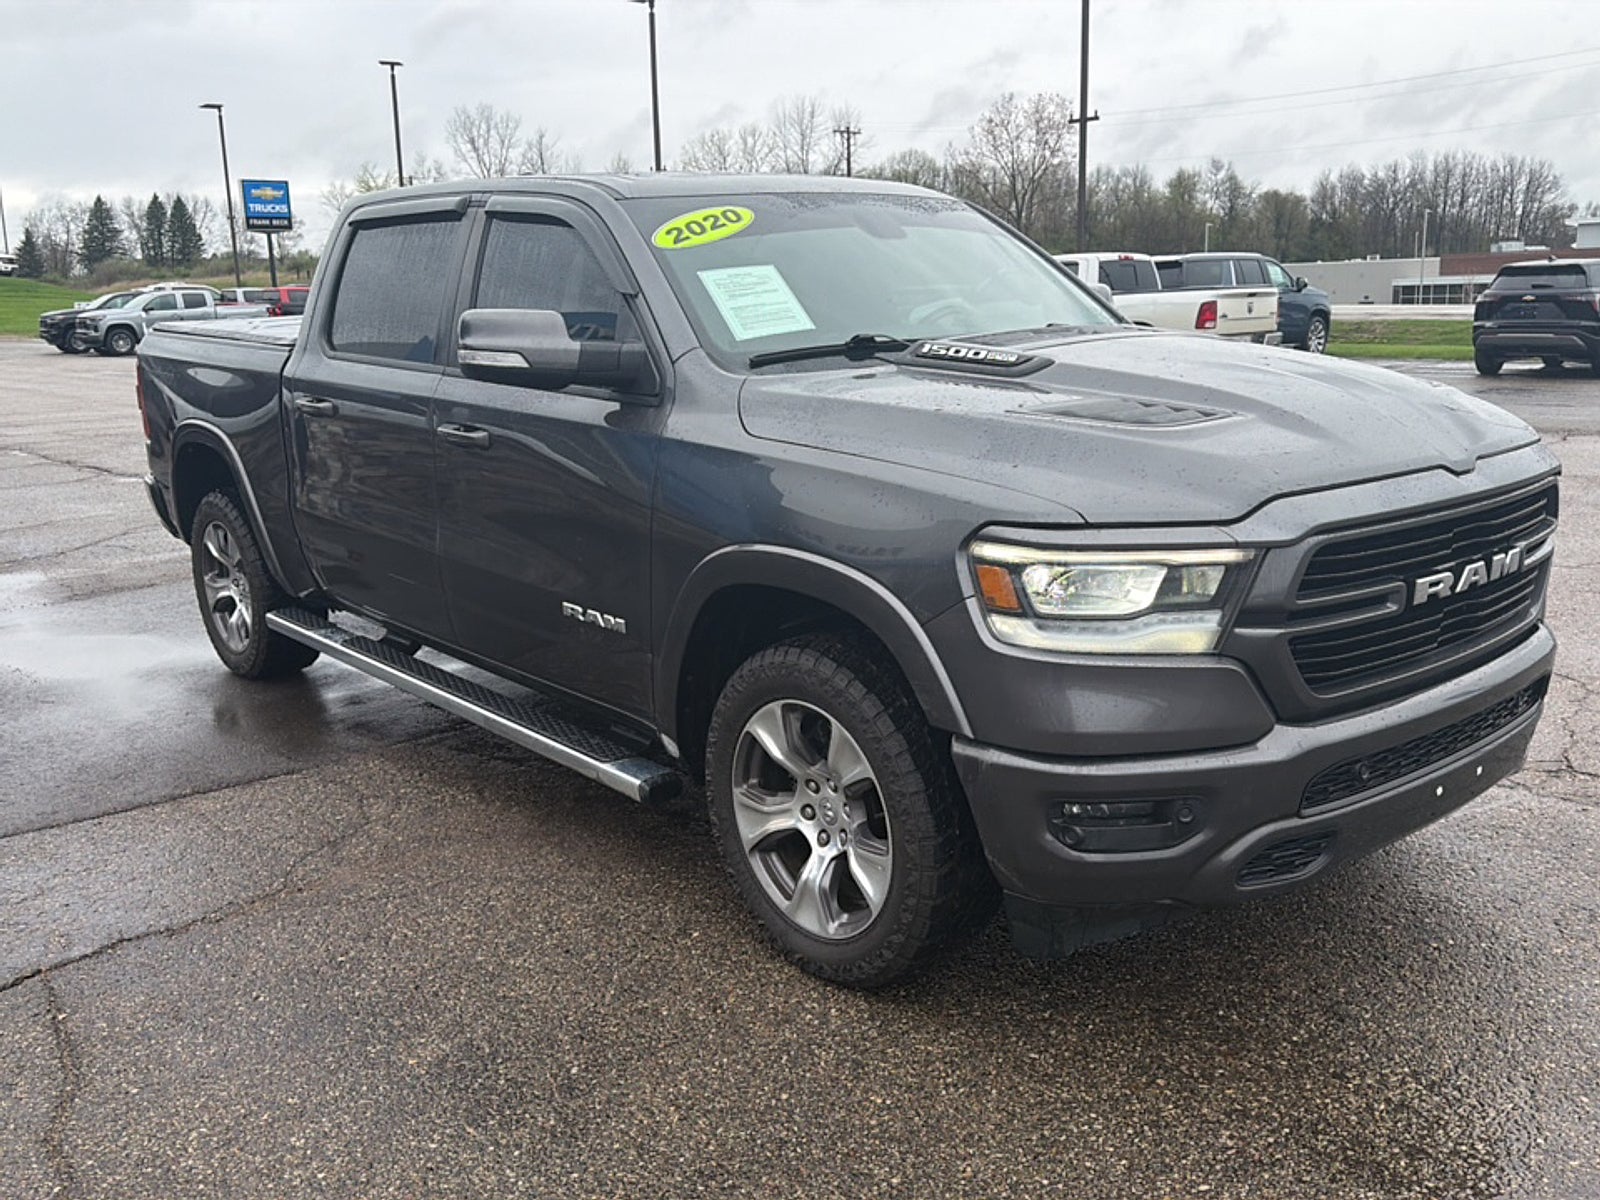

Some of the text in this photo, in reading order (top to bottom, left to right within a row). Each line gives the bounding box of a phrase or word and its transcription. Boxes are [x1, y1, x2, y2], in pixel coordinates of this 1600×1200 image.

[248, 204, 288, 213] TRUCKS
[665, 208, 743, 245] 2020
[921, 343, 988, 359] 1500
[1413, 547, 1521, 606] RAM
[562, 601, 626, 634] RAM
